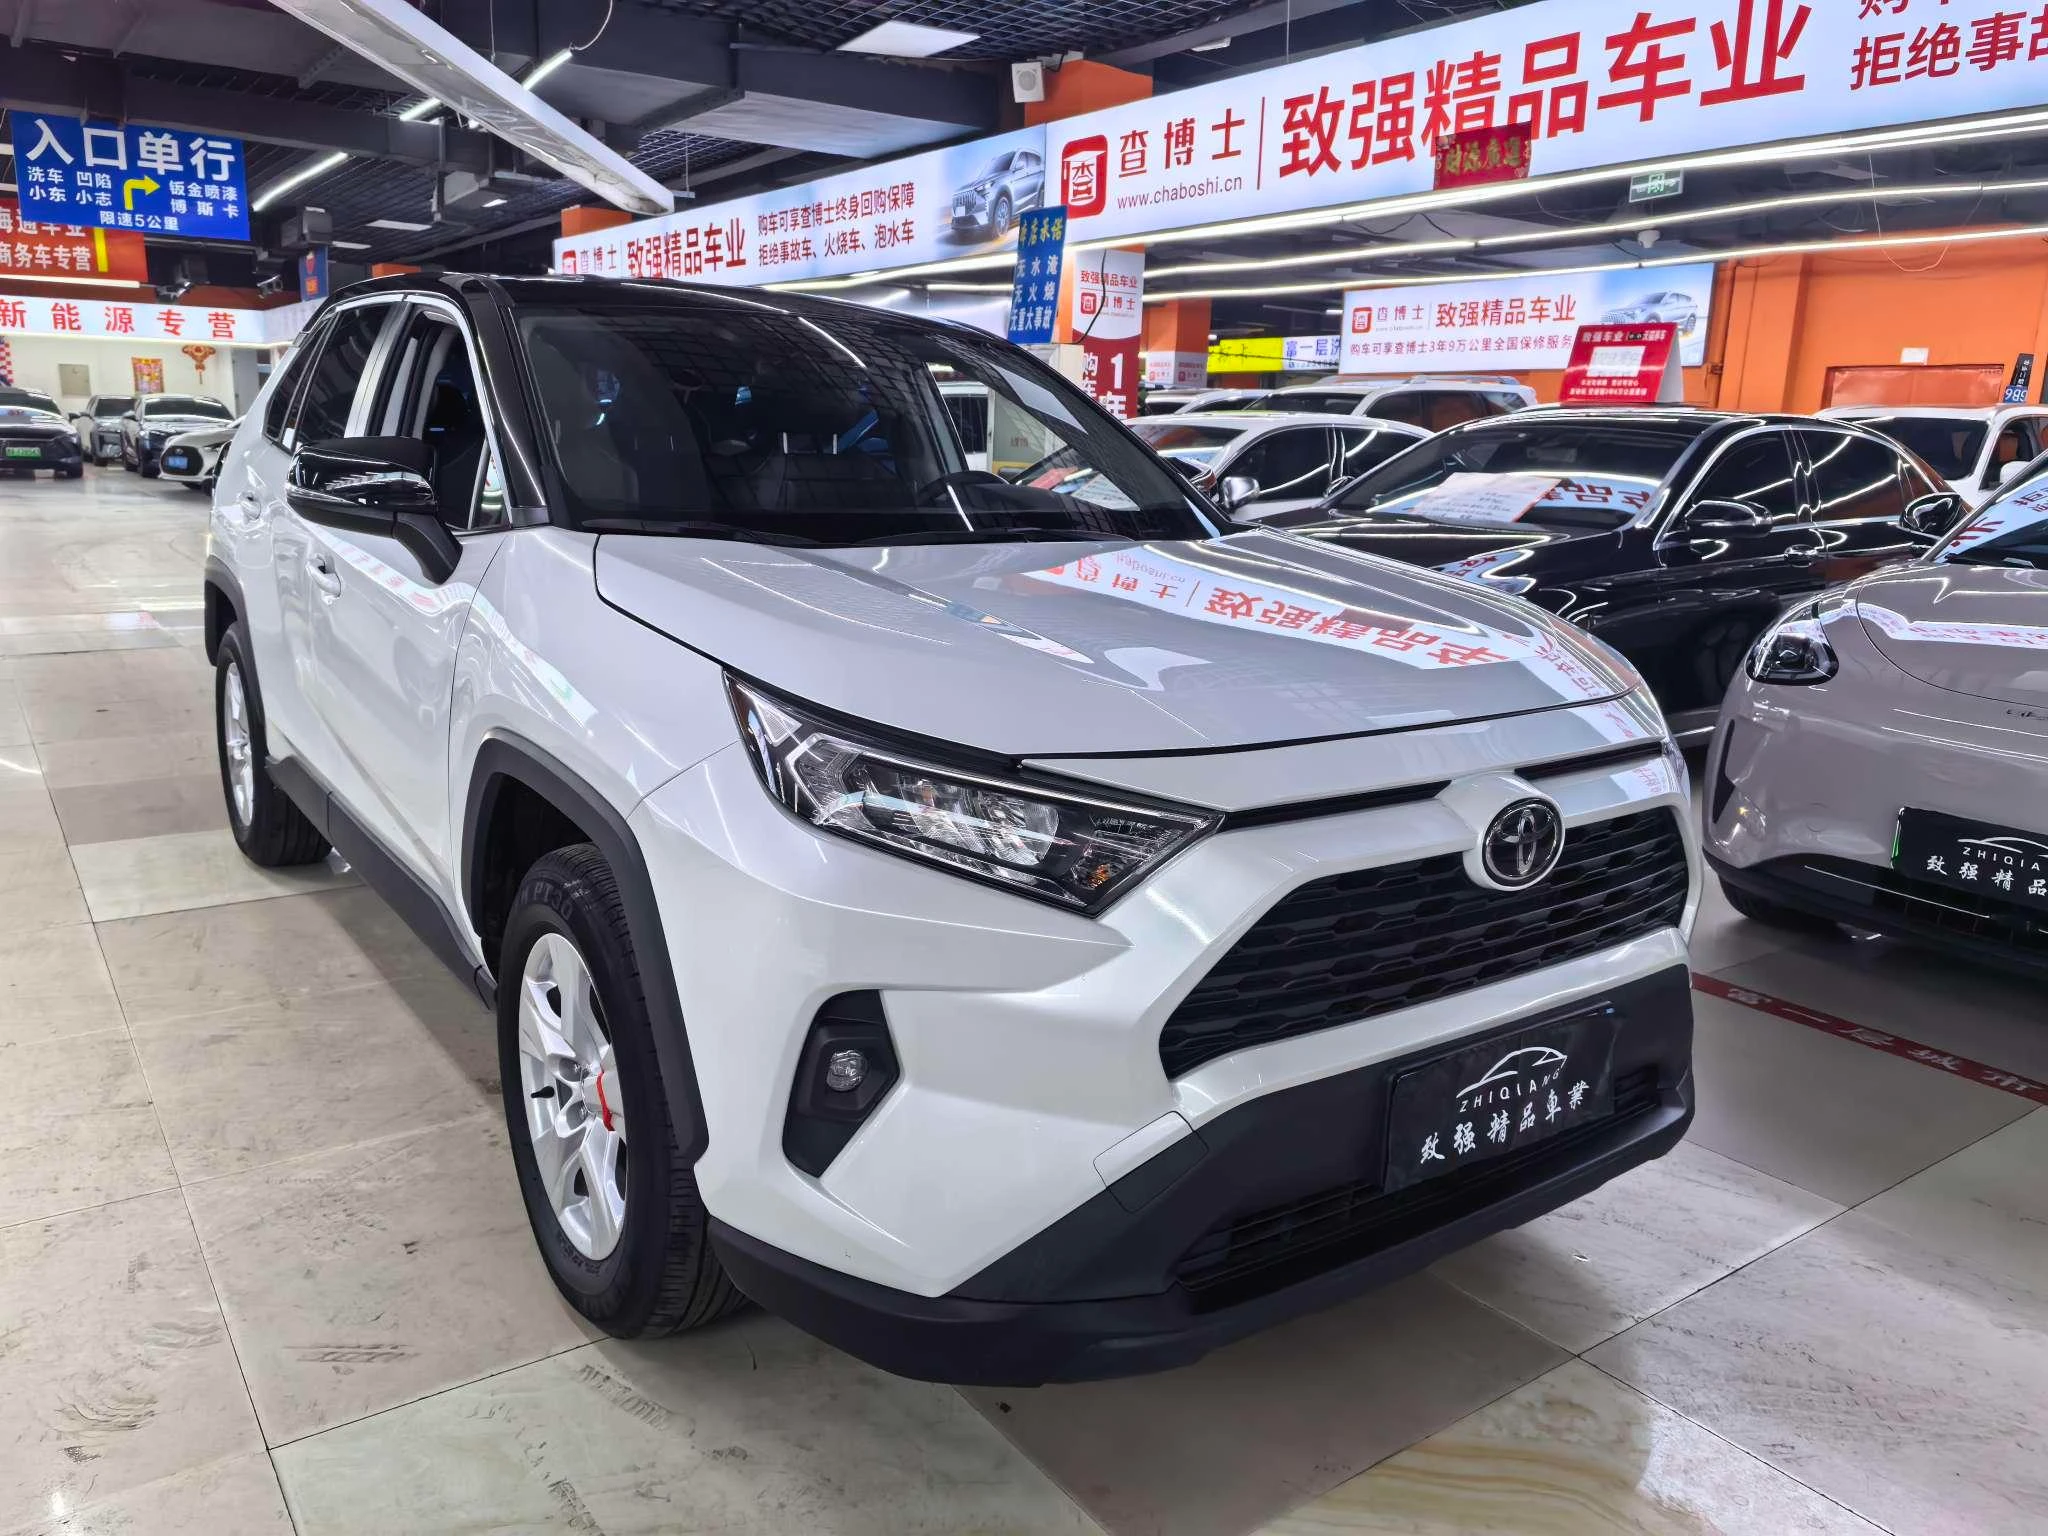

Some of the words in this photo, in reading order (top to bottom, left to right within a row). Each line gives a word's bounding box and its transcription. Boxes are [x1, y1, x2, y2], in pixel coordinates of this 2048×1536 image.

[1278, 0, 1813, 178] 致强精品车业
[26, 118, 236, 182] 入口单行
[1117, 107, 1246, 179] 查博士
[27, 165, 64, 184] 洗车
[76, 170, 112, 190] 凹陷
[29, 185, 67, 203] 小东
[75, 190, 112, 207] 小志
[168, 180, 238, 202] 钣金喷漆
[1117, 173, 1242, 210] www.chaboshi.cn
[99, 209, 180, 232] 限速5公里
[170, 197, 239, 219] 博斯卡
[757, 180, 915, 236] 购车可享查博士终身回购保障
[626, 216, 747, 280] 致强精品车业
[0, 300, 236, 339] 新能源专营
[1377, 303, 1425, 321] 查博士
[1435, 293, 1577, 329] 致强精品车业
[1926, 854, 2048, 897] 致强精品
[1459, 1067, 1561, 1113] ZHIQIANG
